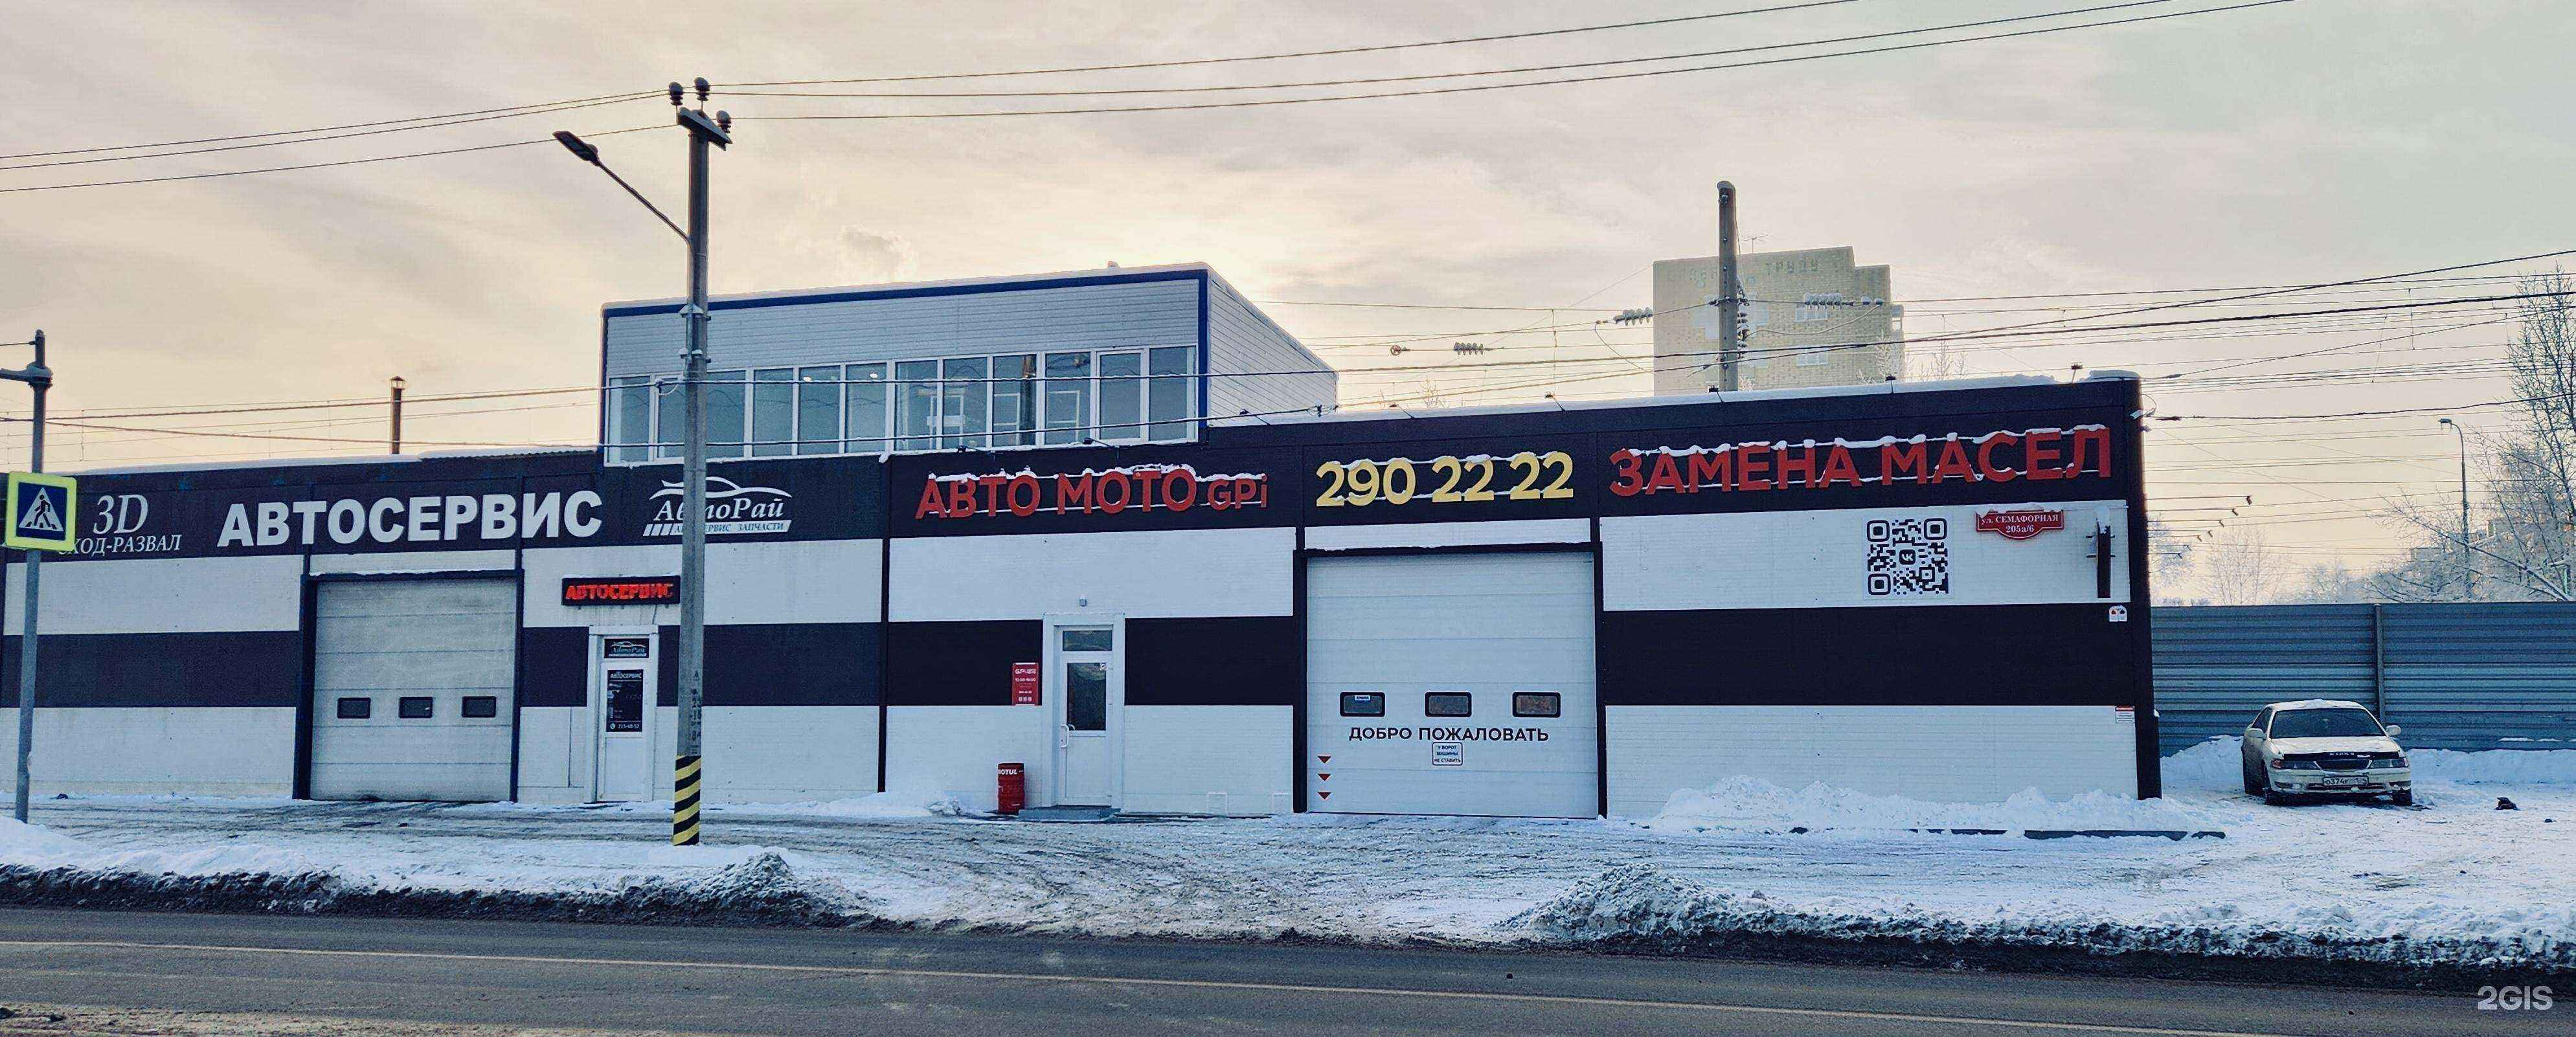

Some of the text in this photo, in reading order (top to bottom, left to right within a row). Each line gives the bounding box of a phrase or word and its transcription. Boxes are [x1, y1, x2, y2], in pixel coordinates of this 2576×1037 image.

[1609, 427, 2111, 496] ЗАМЕНА МАСЕЛ
[1316, 451, 1574, 507] 290 22 22
[93, 494, 148, 535] 3D
[216, 489, 602, 548] АВТОСЕРВИС
[653, 498, 784, 522] АоРай
[1995, 514, 2059, 523] СЕМАФОРНАЯ
[60, 534, 182, 557] ХОД-РАЗВАЛ
[565, 584, 673, 600] АВТОСЕРВИС
[1349, 727, 1549, 742] ДОБРО ПОЖАЛОВАТЬ
